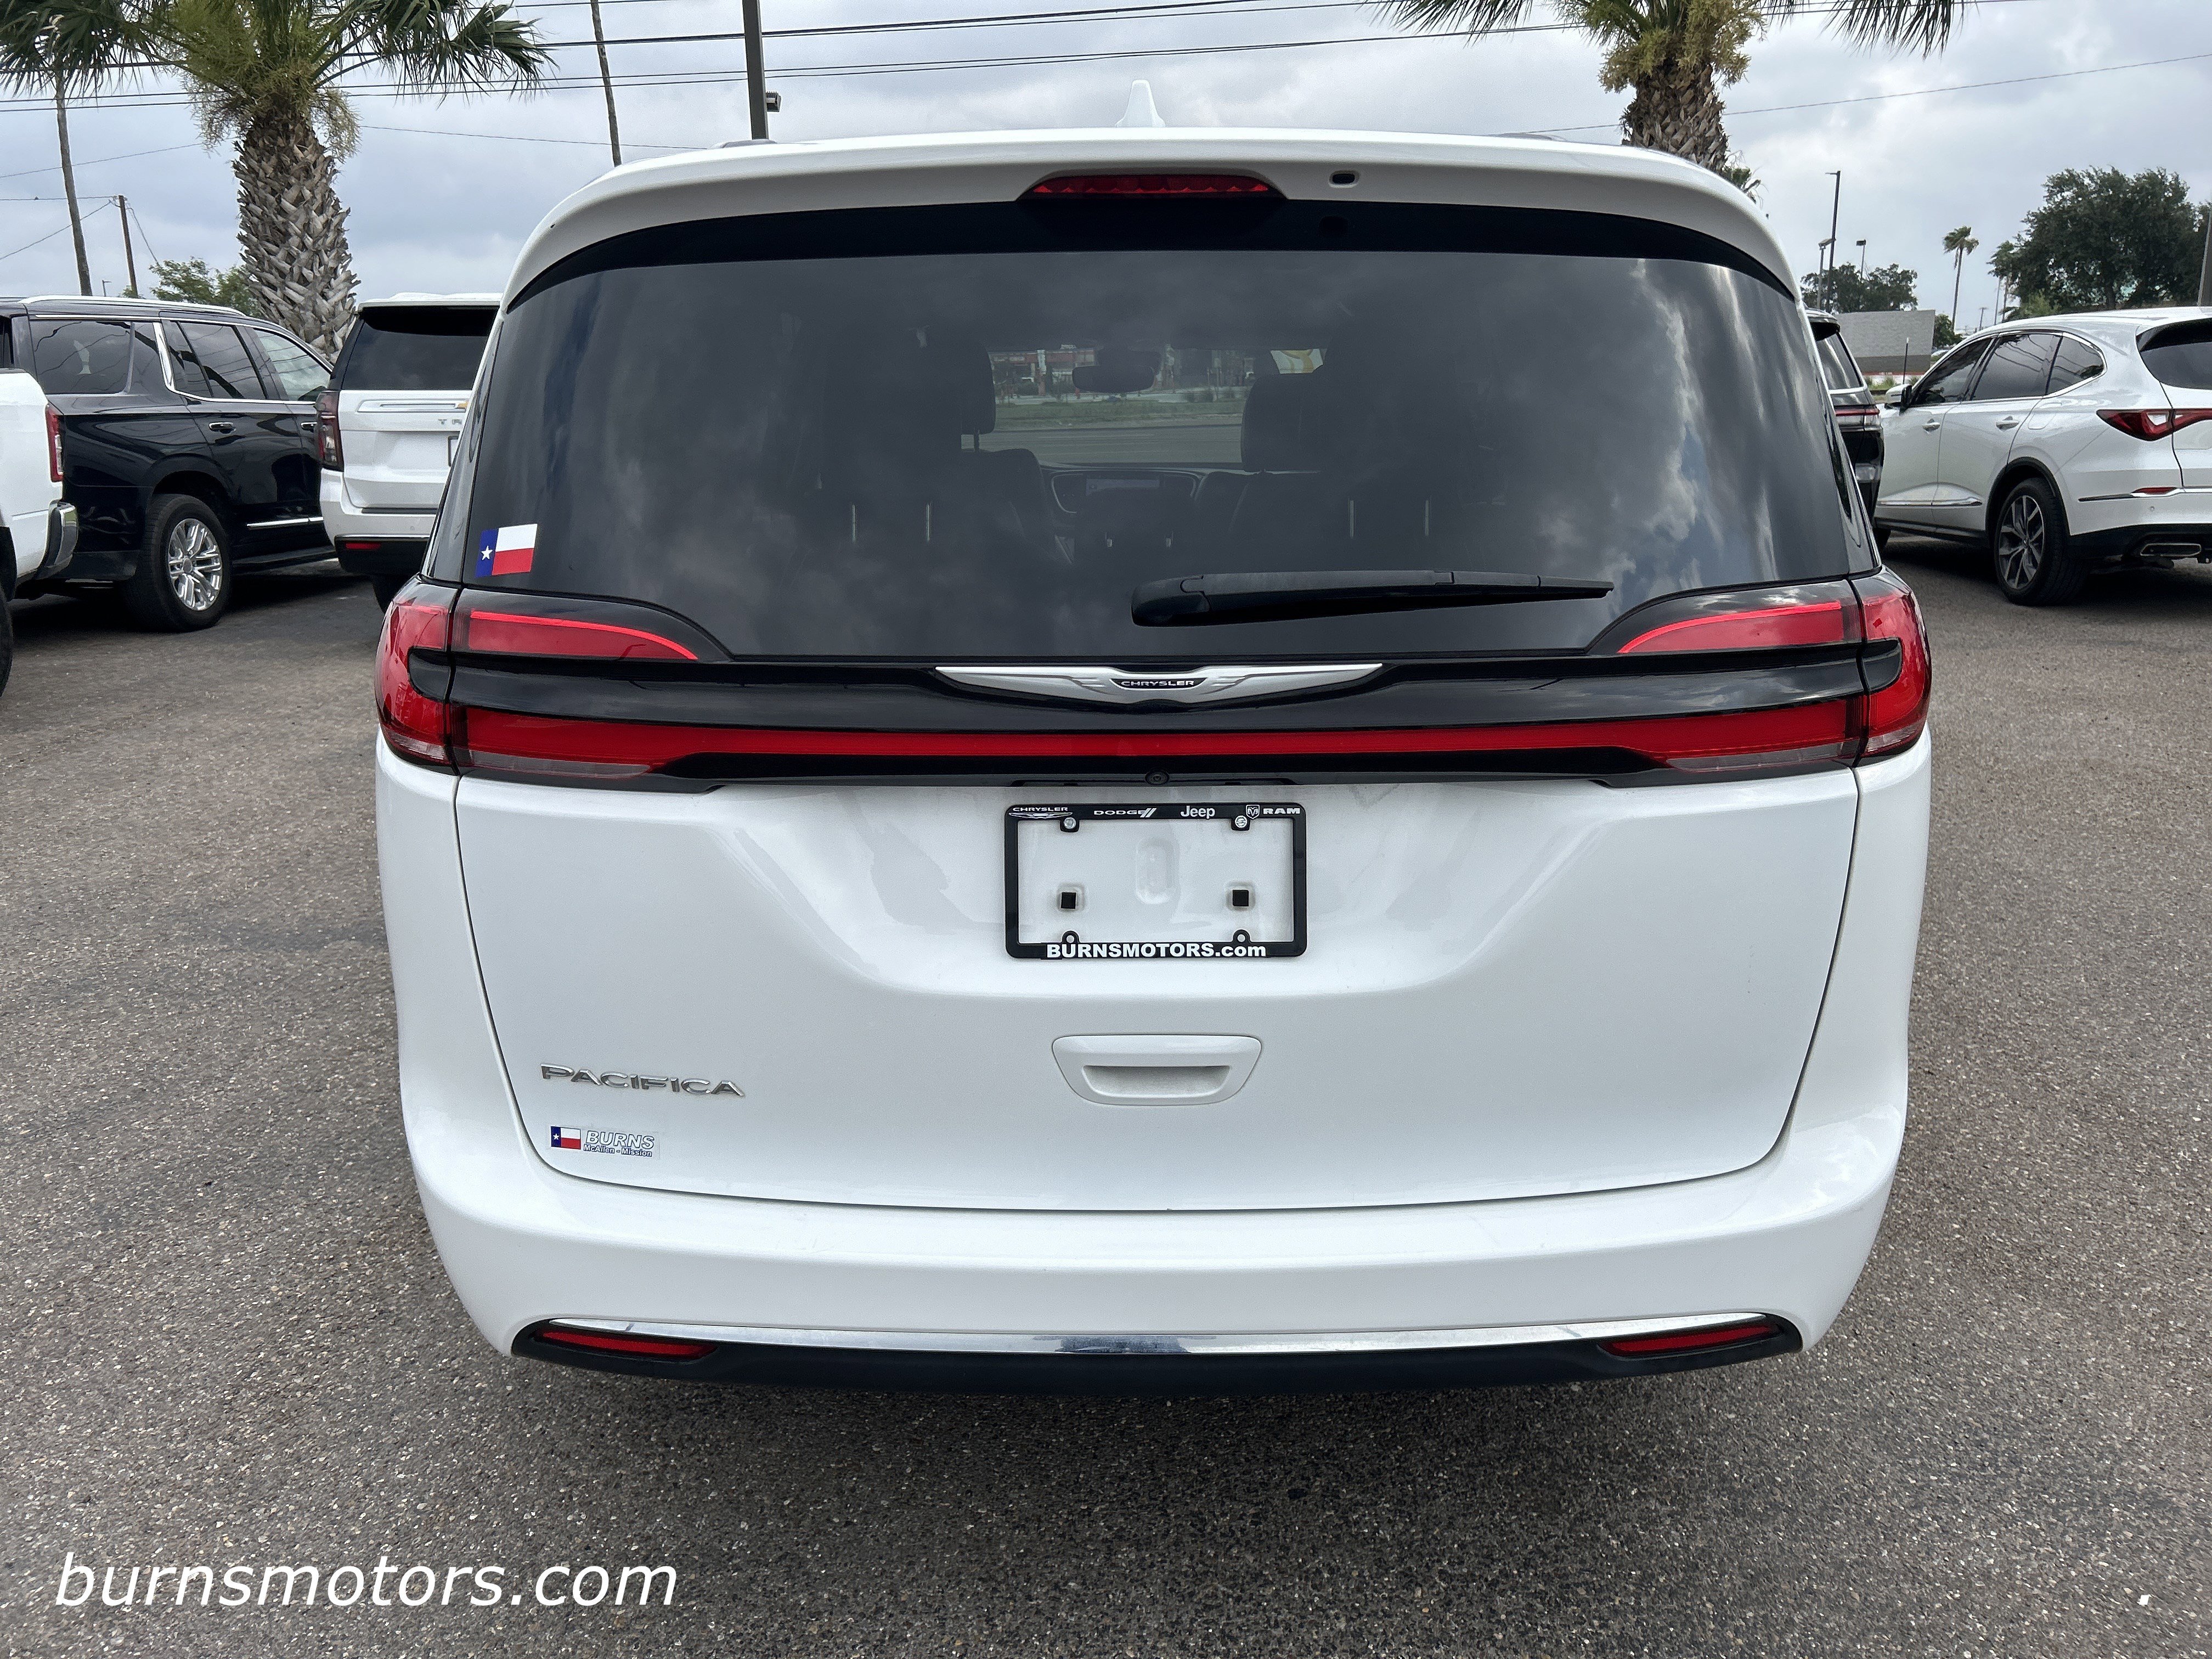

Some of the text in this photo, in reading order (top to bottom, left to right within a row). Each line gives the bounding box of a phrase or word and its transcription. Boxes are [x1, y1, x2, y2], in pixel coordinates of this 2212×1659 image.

[1180, 805, 1215, 819] Jeep
[1047, 943, 1266, 958] BURNSMOTORS.com
[540, 1062, 744, 1097] PACIFICA
[586, 1130, 654, 1149] BURNS
[583, 1144, 615, 1154] McAllen
[621, 1147, 652, 1157] Mission
